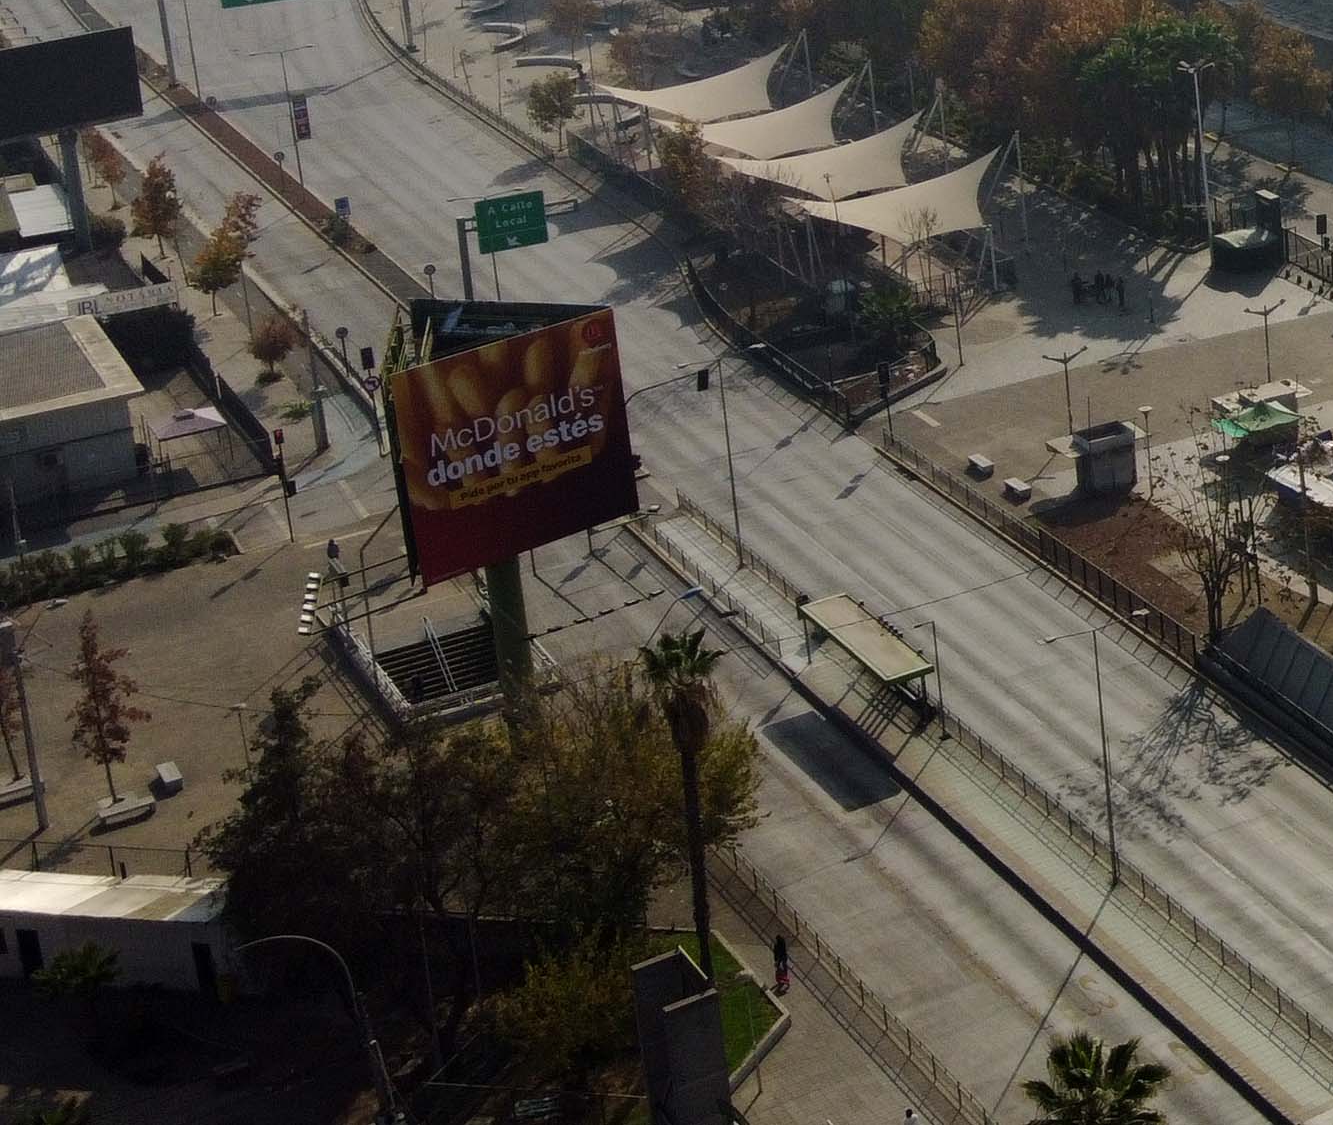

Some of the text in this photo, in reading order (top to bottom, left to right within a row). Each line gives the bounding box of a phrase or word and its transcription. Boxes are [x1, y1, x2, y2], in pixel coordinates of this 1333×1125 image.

[495, 213, 527, 228] Local
[427, 412, 604, 488] donde estés
[430, 385, 596, 457] McDonald's
[460, 453, 583, 501] Pide por tu app favorita
